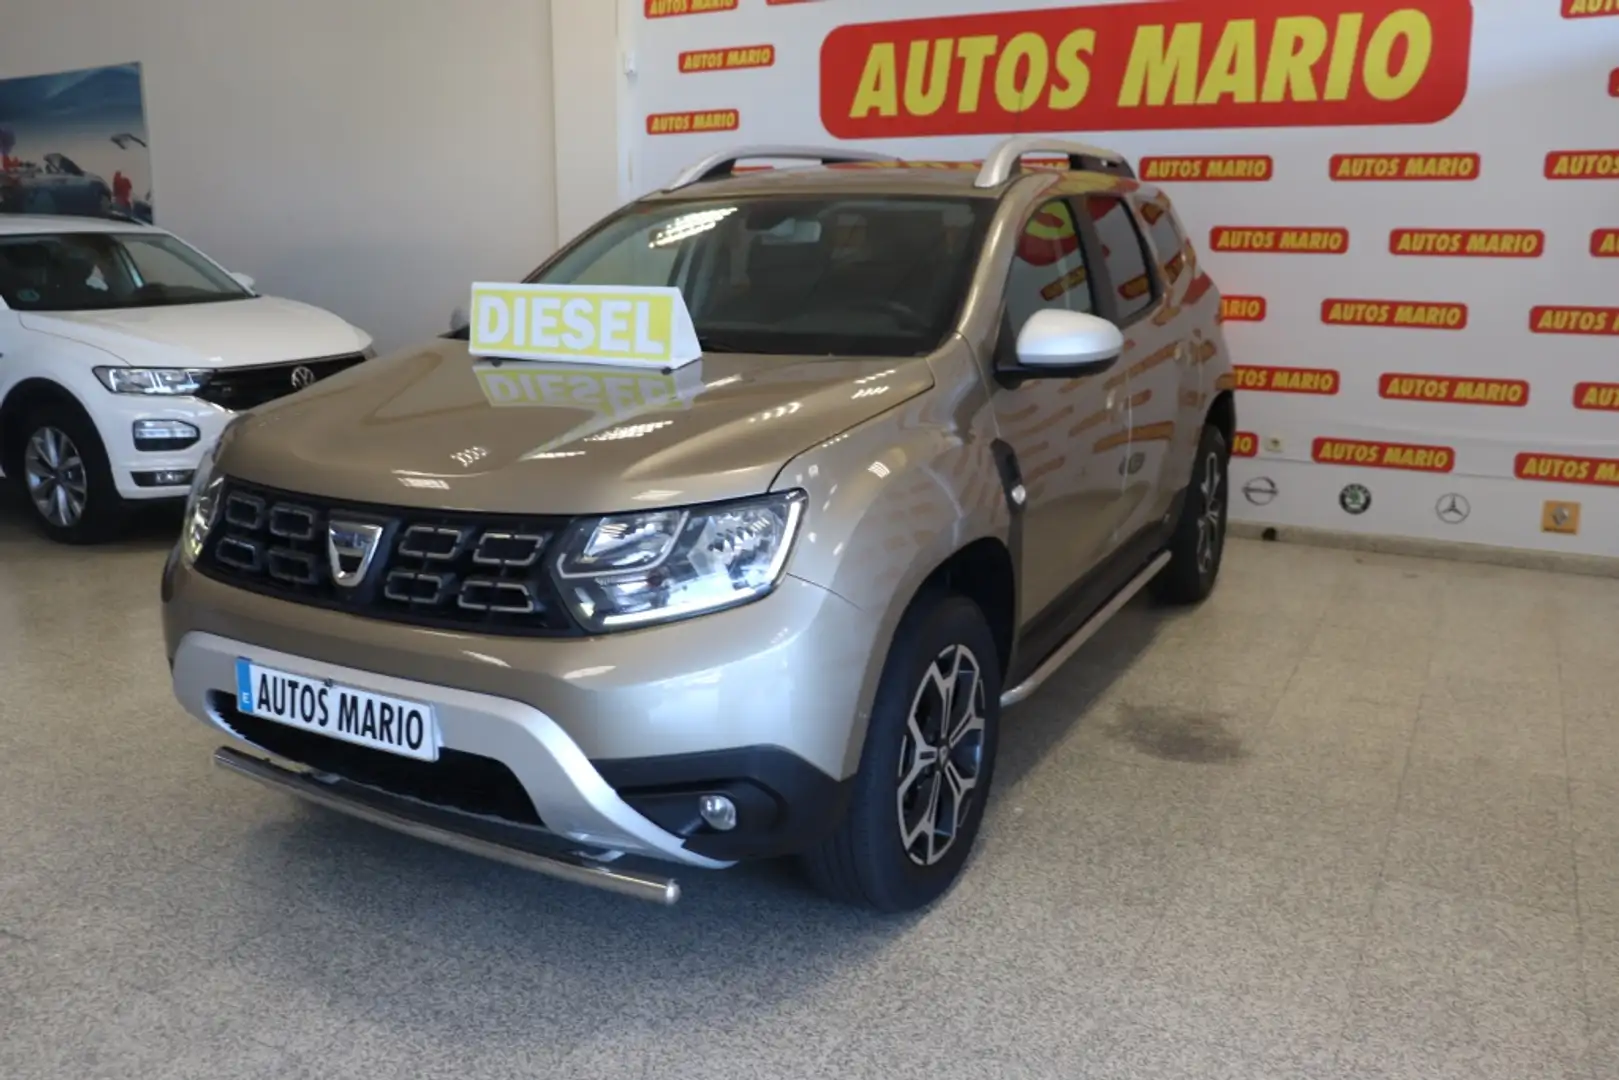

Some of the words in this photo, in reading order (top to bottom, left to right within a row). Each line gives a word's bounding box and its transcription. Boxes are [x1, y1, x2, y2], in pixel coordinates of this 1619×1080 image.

[650, 0, 687, 15] AUTOS
[1569, 0, 1619, 14] AUT
[683, 52, 724, 70] AUTOS
[726, 48, 771, 66] MARIO
[849, 28, 1097, 118] AUTOS
[1117, 8, 1434, 108] MARIO
[651, 115, 690, 132] AUTOS
[692, 112, 736, 130] MARIO
[1146, 160, 1201, 178] AUTOS
[1206, 159, 1267, 177] MARIO
[1337, 158, 1400, 177] AUTOS
[1404, 157, 1474, 176] MARIO
[1217, 231, 1274, 249] AUTOS
[1279, 231, 1342, 250] MARIO
[1397, 233, 1462, 252] AUTOS
[1466, 233, 1538, 254] MARIO
[1223, 300, 1260, 318] RIO
[1329, 303, 1389, 322] AUTOS
[1394, 305, 1461, 326] MARIO
[478, 295, 664, 355] DIESEL
[1537, 310, 1609, 331] AUTOS
[1235, 368, 1268, 387] TOS
[1272, 371, 1334, 391] MARIO
[1386, 378, 1449, 398] AUTOS
[1454, 381, 1523, 402] MARIO
[1319, 442, 1378, 463] AUTOS
[1383, 447, 1448, 468] MARIO
[1522, 457, 1591, 480] AUTOS
[242, 691, 251, 705] E
[257, 673, 330, 727] AUTOS
[337, 692, 424, 750] MARIO
